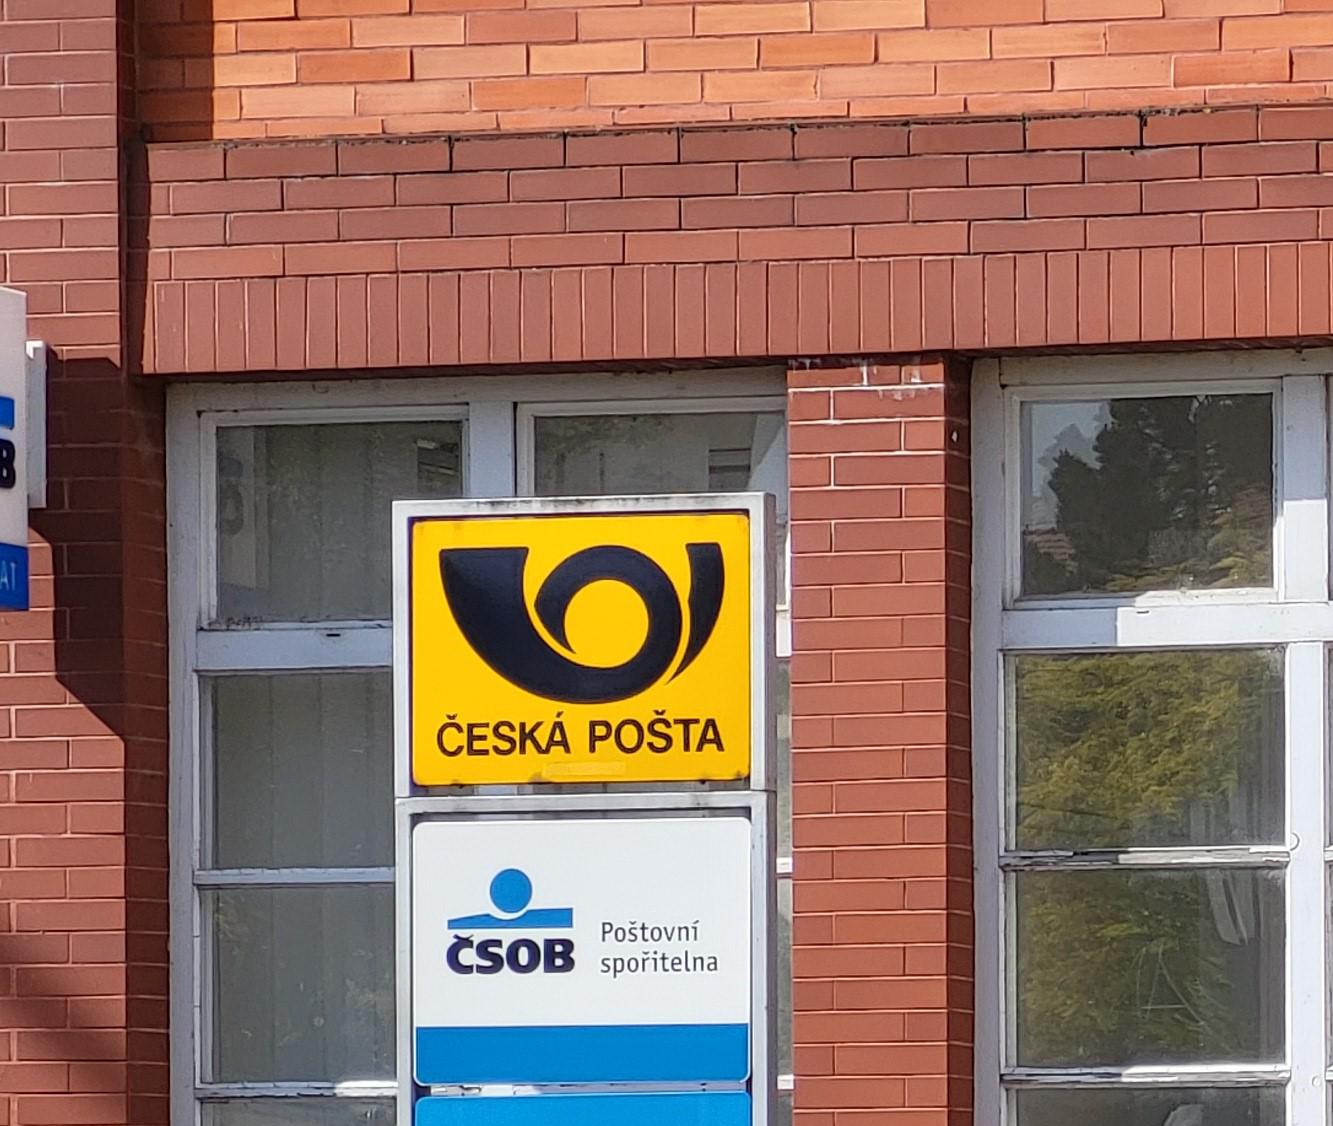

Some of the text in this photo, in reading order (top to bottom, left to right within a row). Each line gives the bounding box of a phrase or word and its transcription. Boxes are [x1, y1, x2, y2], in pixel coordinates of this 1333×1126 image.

[436, 708, 726, 758] ČESKÁ POŠTA
[600, 918, 700, 944] Poštovní
[446, 933, 576, 976] ČSOB
[600, 948, 719, 980] spořitelna
